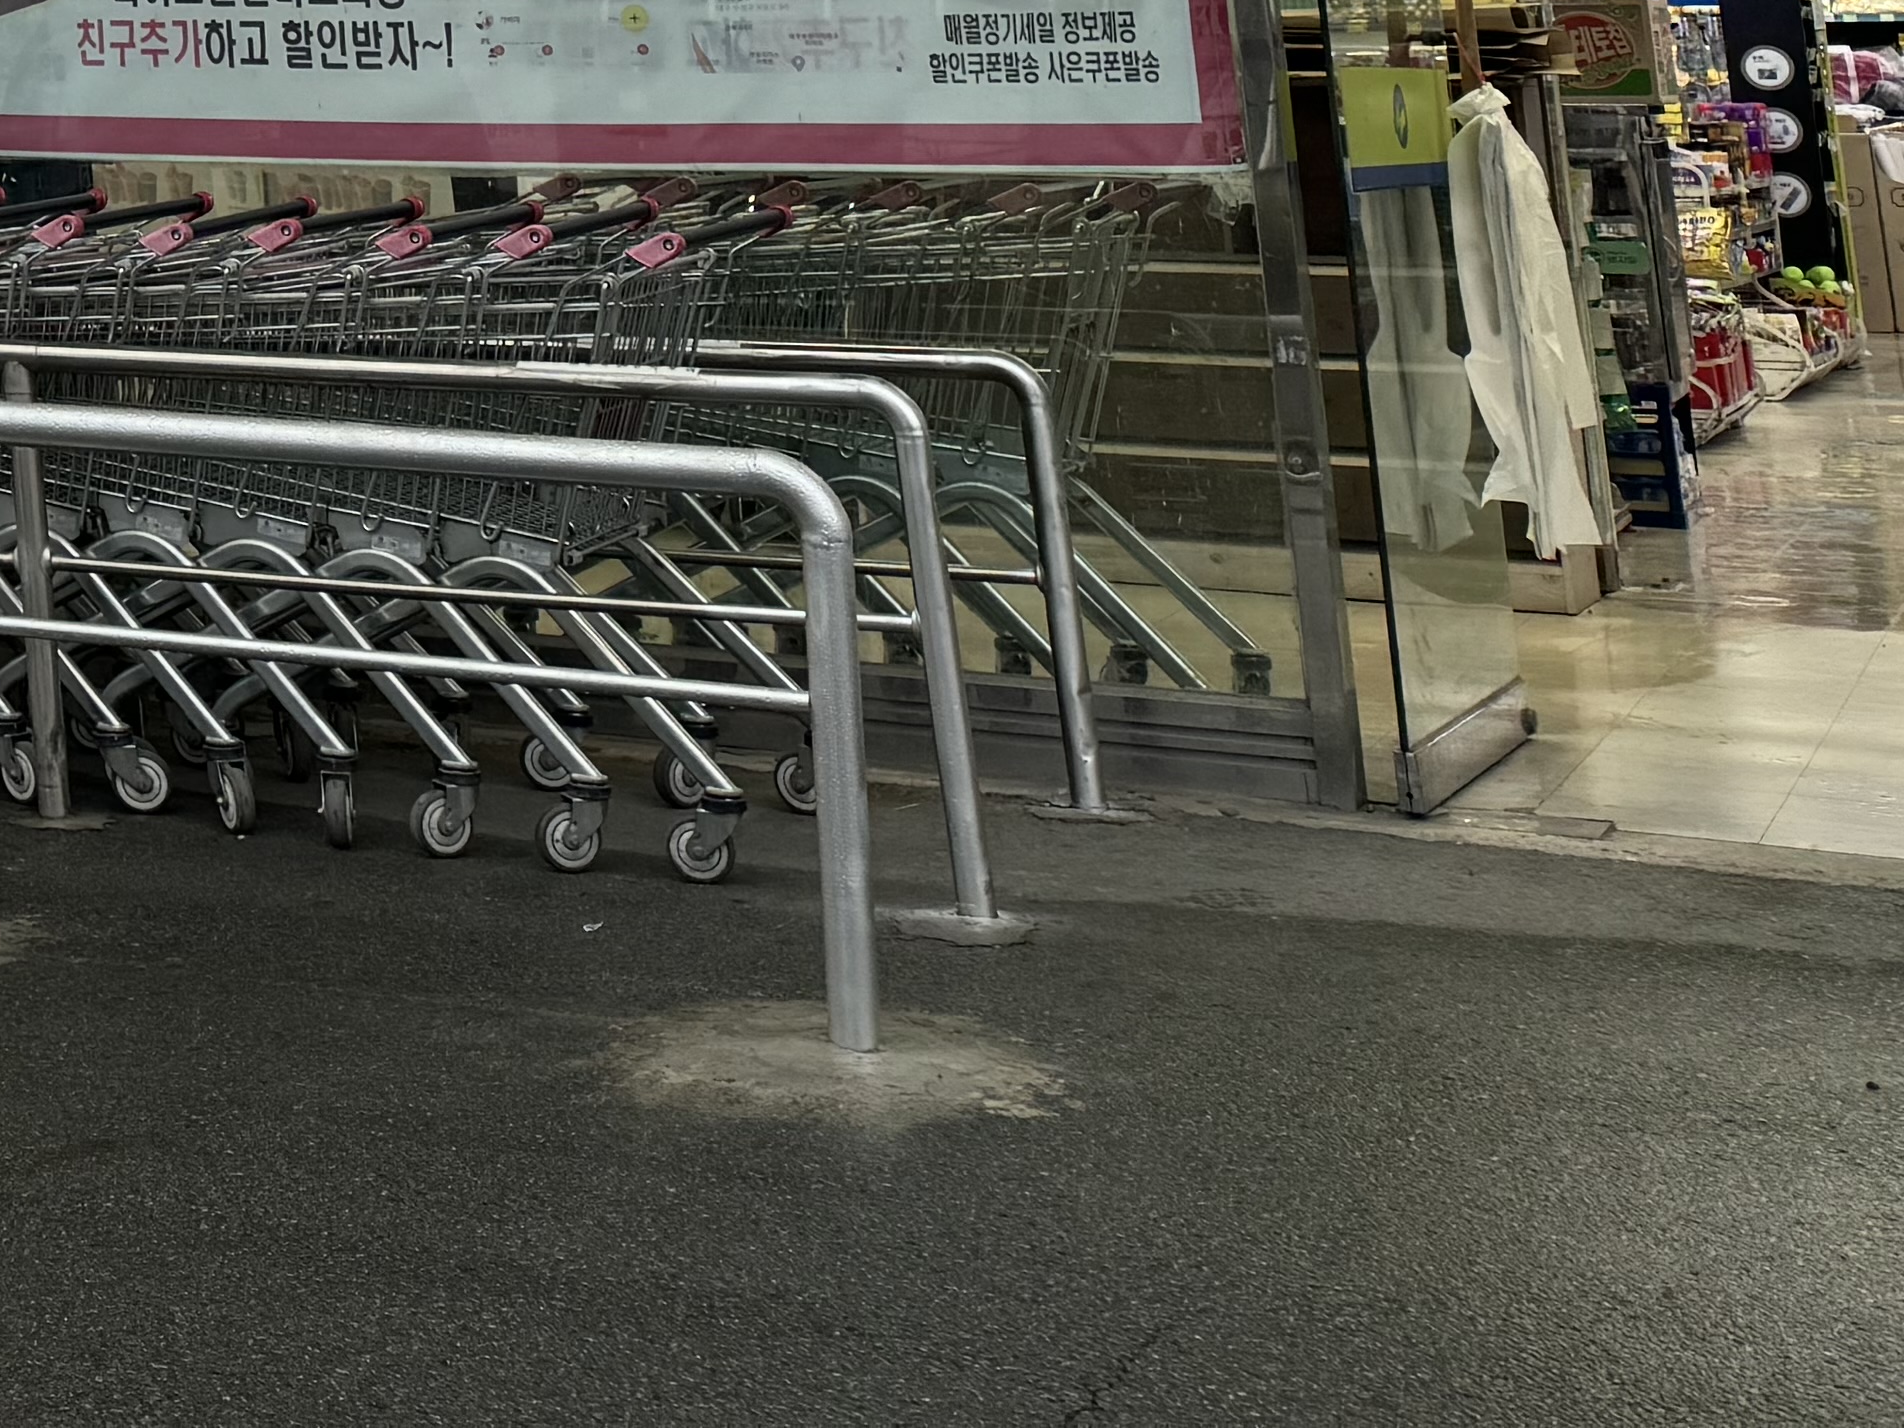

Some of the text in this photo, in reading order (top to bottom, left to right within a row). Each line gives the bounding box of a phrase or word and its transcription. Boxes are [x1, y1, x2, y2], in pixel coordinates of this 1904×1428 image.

[76, 18, 455, 71] 친구추가하고 할인받자~!
[944, 11, 1136, 45] 매월정기세일 정보제공
[929, 50, 1160, 84] 할인쿠폰발송 사은쿠폰발송
